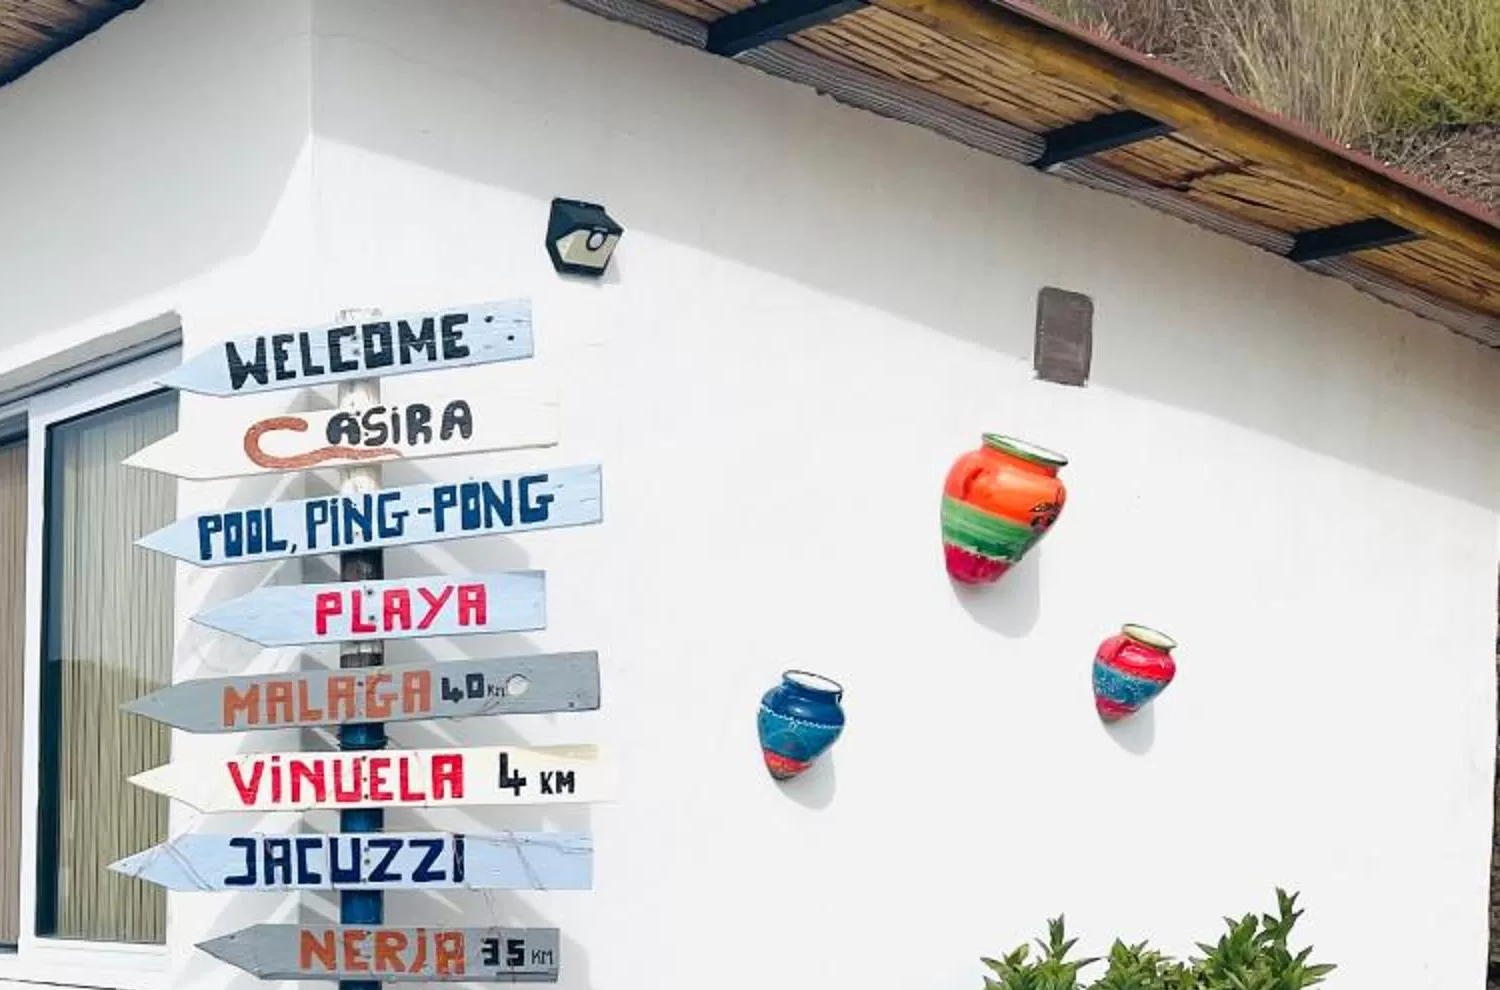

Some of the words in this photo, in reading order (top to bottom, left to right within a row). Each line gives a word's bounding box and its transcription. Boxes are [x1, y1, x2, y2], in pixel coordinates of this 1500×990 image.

[226, 313, 470, 389] WELCOME
[198, 508, 297, 561] POOL,
[315, 582, 488, 636] PLAYA
[223, 670, 431, 726] MALAGA
[440, 673, 486, 704] 40
[499, 752, 526, 797] 4
[539, 768, 576, 796] KM
[480, 938, 526, 967] 35
[531, 949, 554, 965] KM
